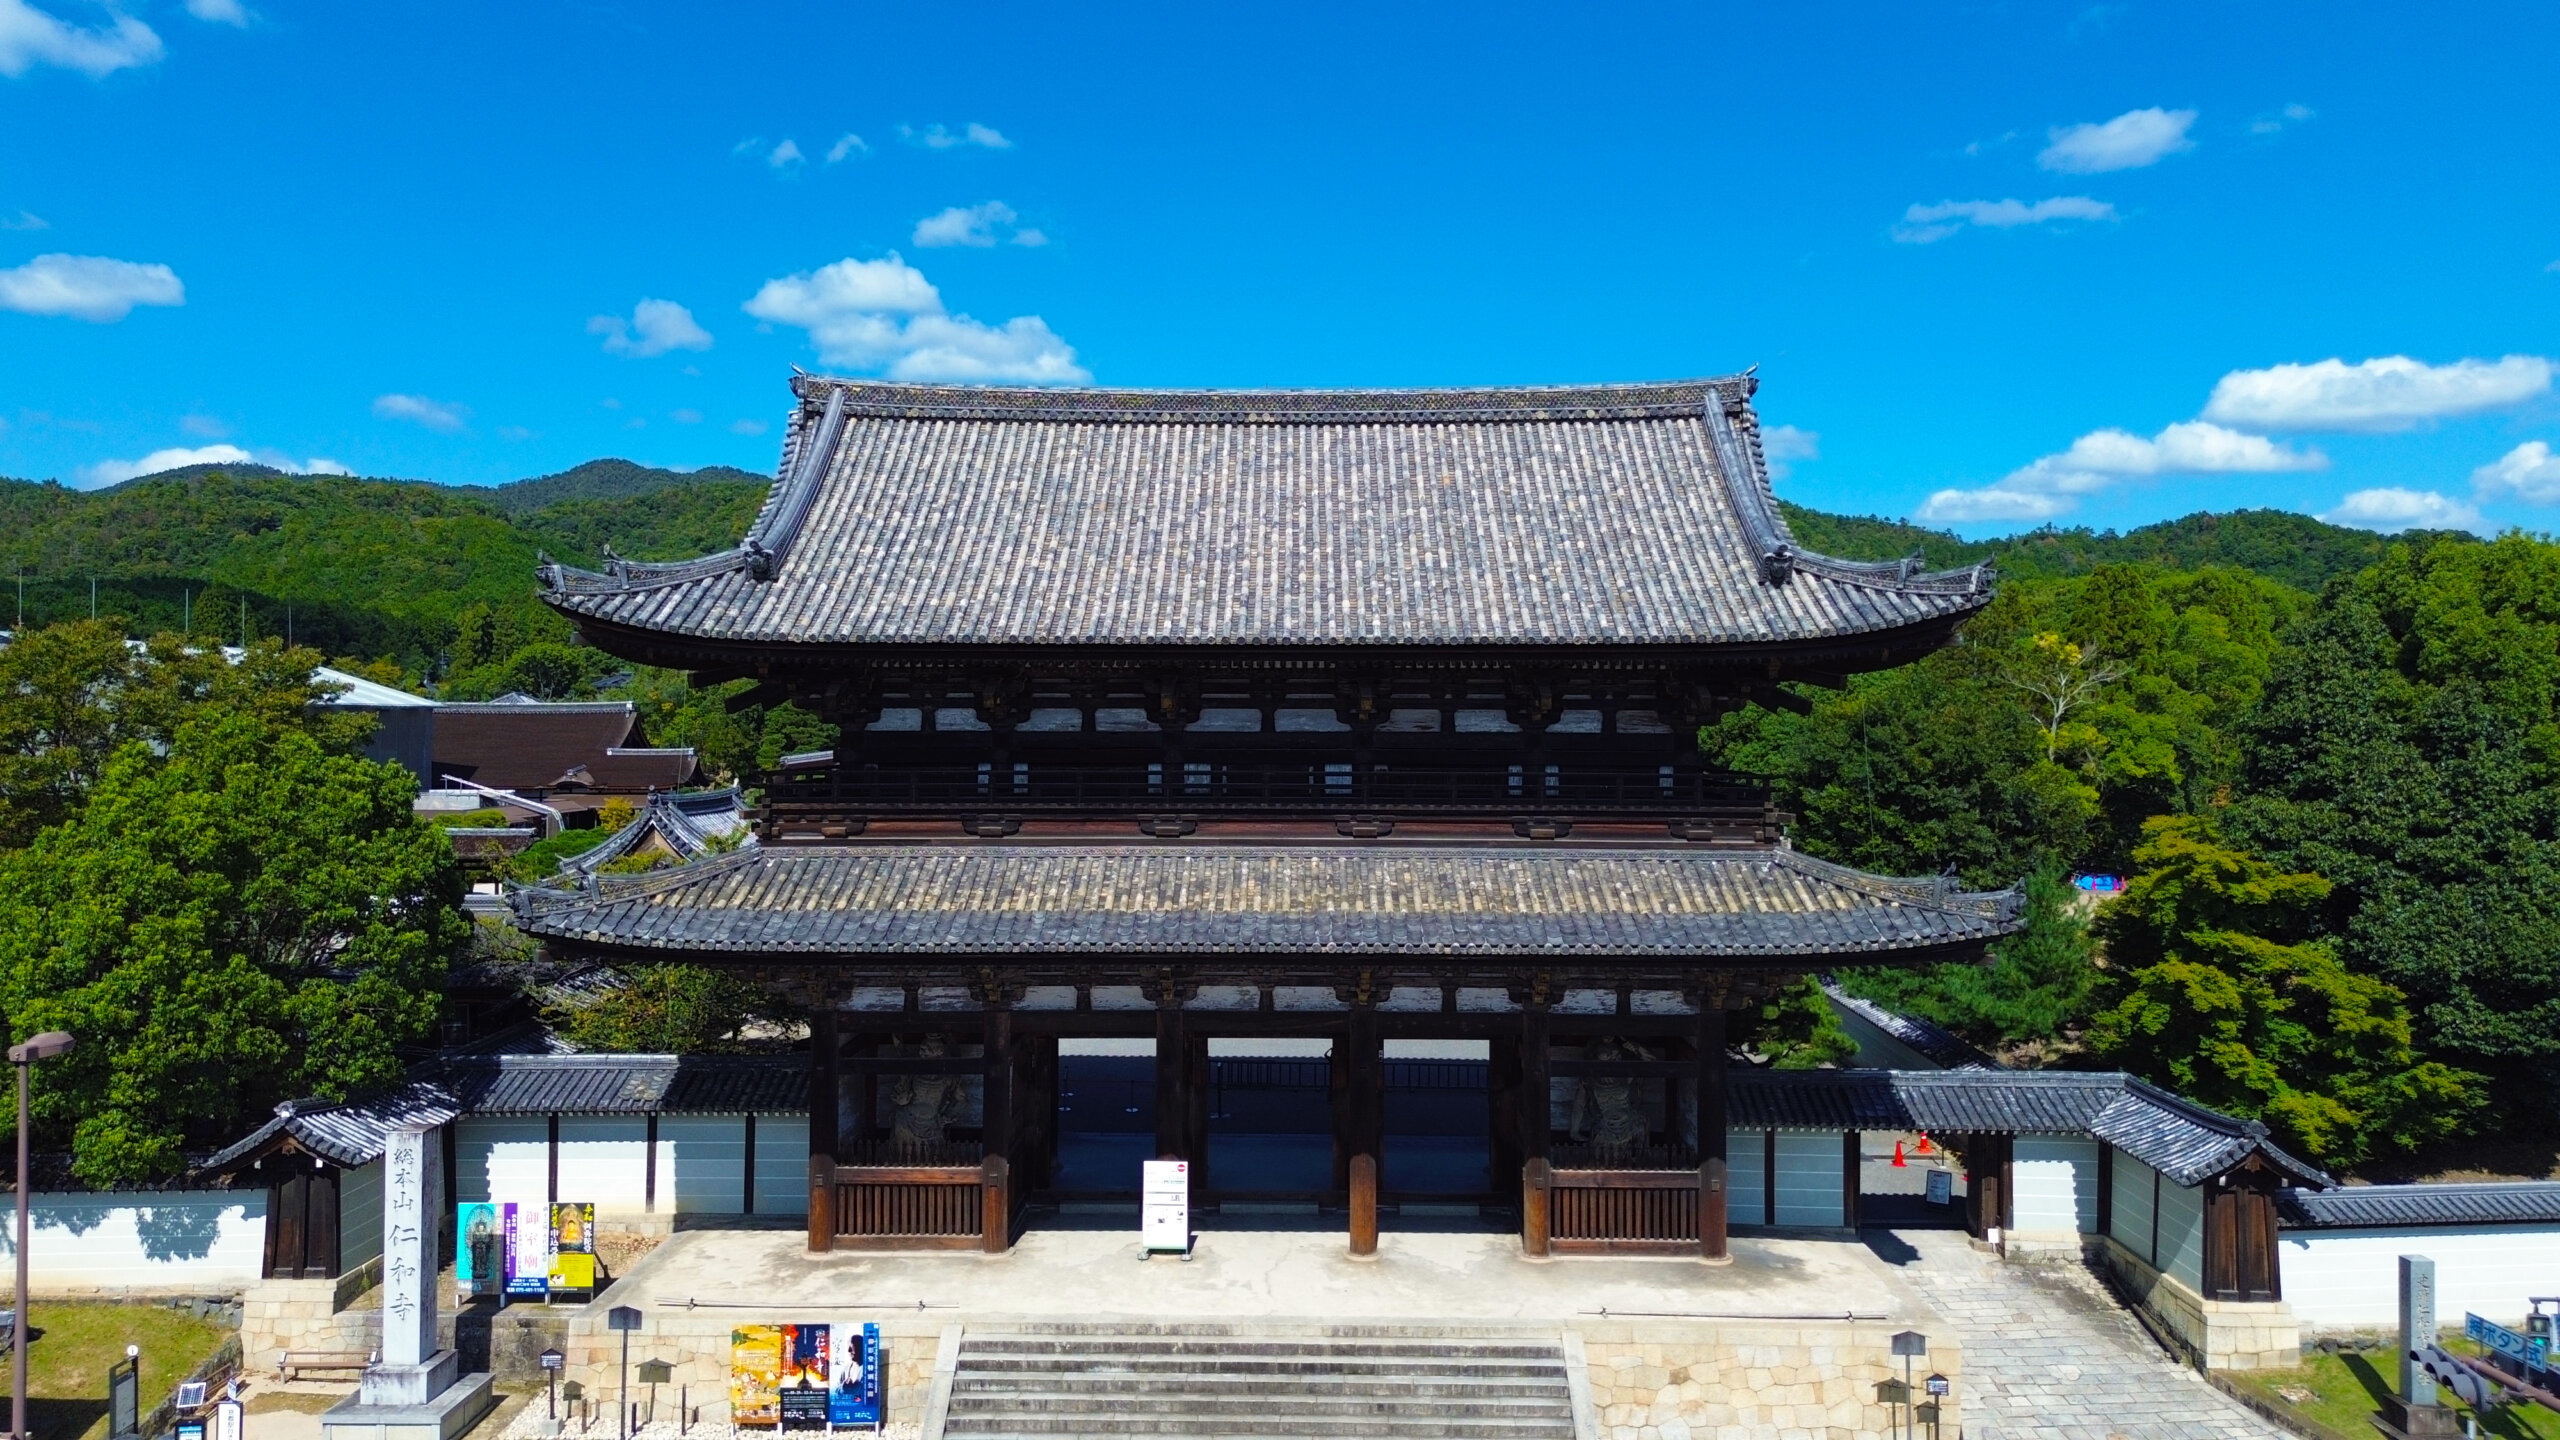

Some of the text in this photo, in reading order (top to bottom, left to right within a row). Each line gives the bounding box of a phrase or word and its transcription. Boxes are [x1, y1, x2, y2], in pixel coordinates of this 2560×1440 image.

[387, 1148, 418, 1321] 総本山仁和寺
[815, 1338, 826, 1374] 仁和寺
[2468, 1317, 2542, 1366] 押ボタン式
